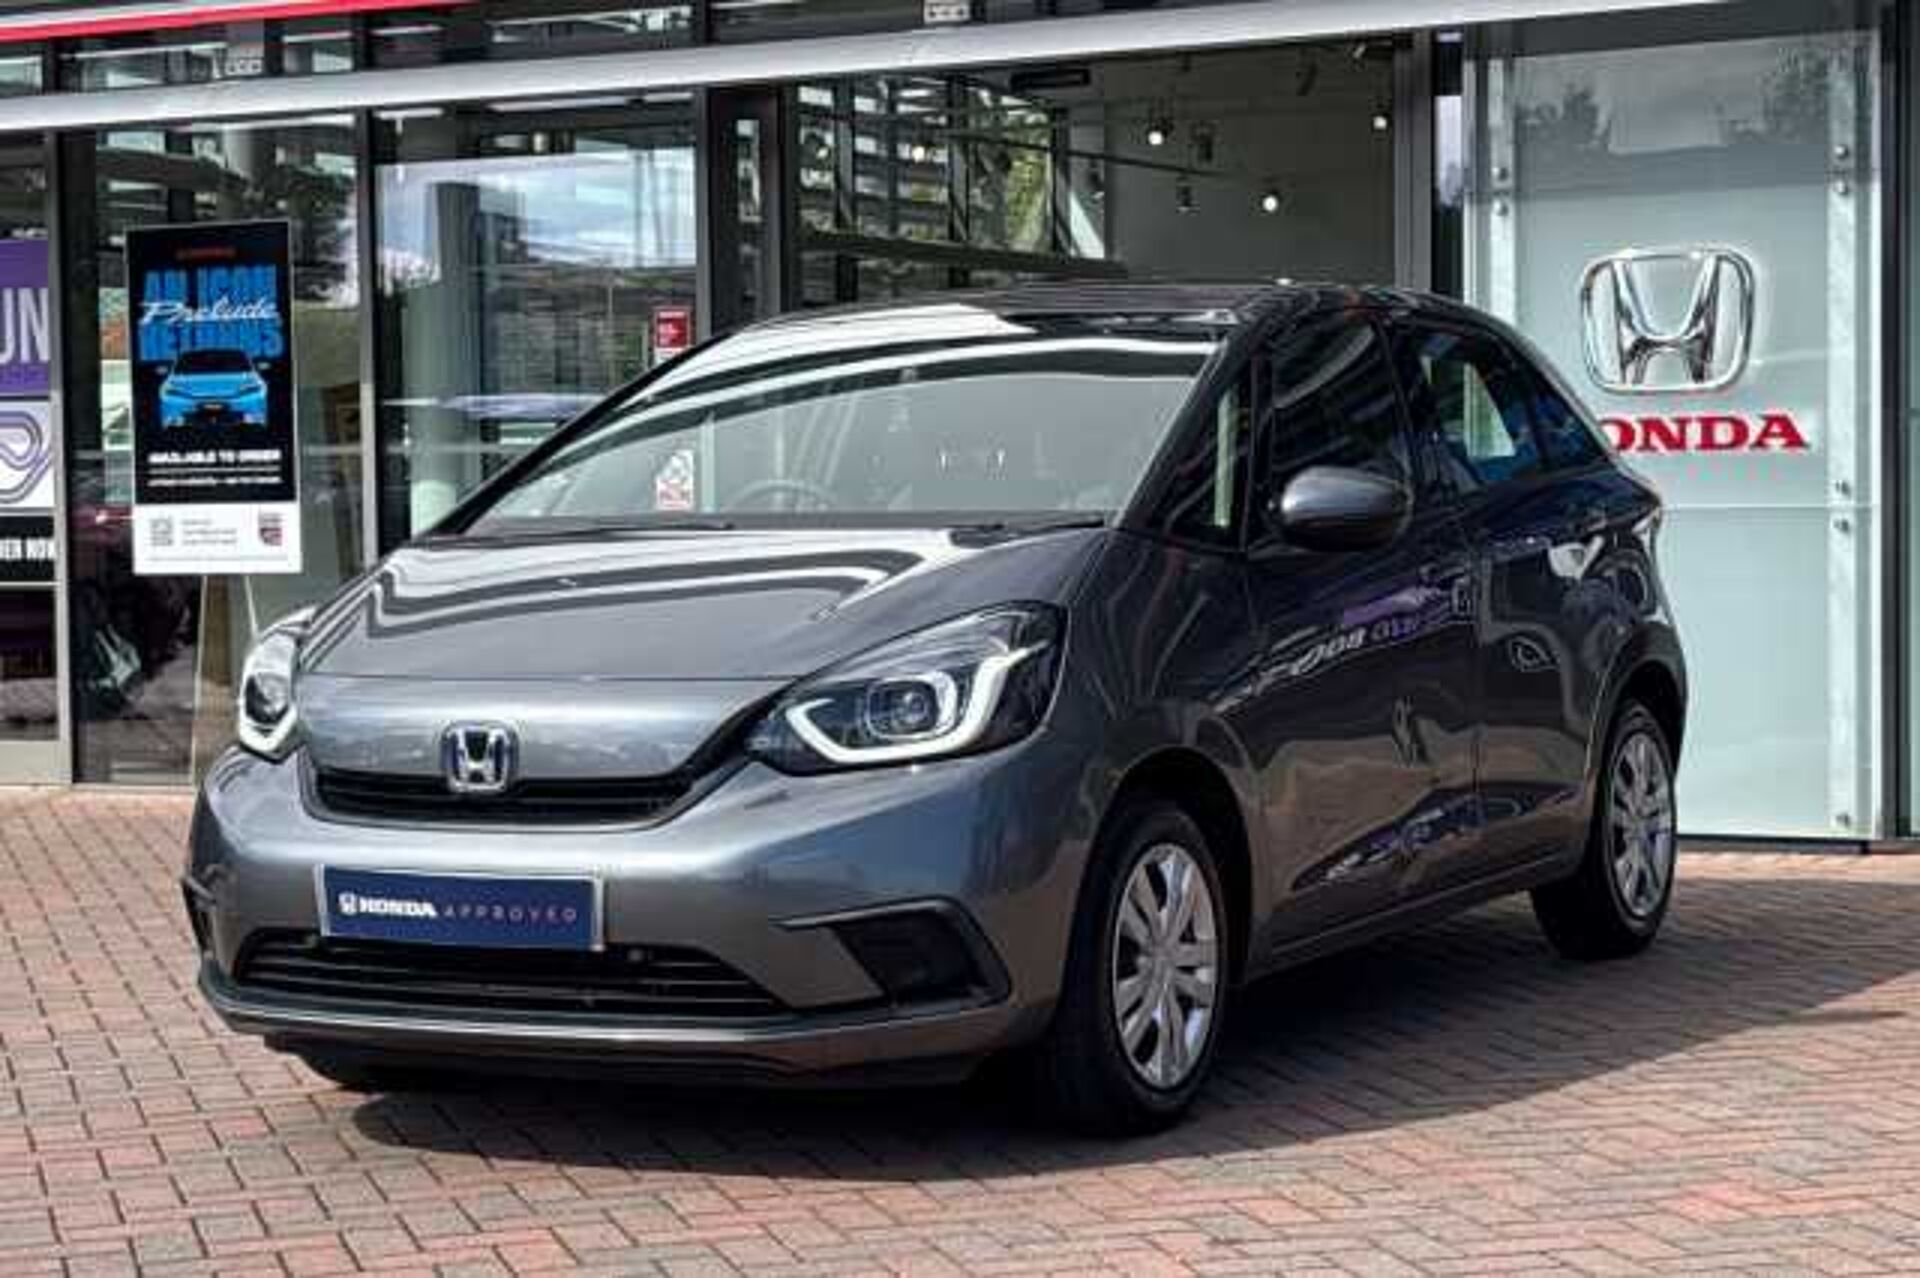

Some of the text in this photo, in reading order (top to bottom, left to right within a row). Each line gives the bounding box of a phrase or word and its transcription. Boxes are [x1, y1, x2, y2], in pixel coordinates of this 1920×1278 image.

[138, 294, 282, 325] Prelude
[358, 895, 578, 923] HONDA APPROVED
